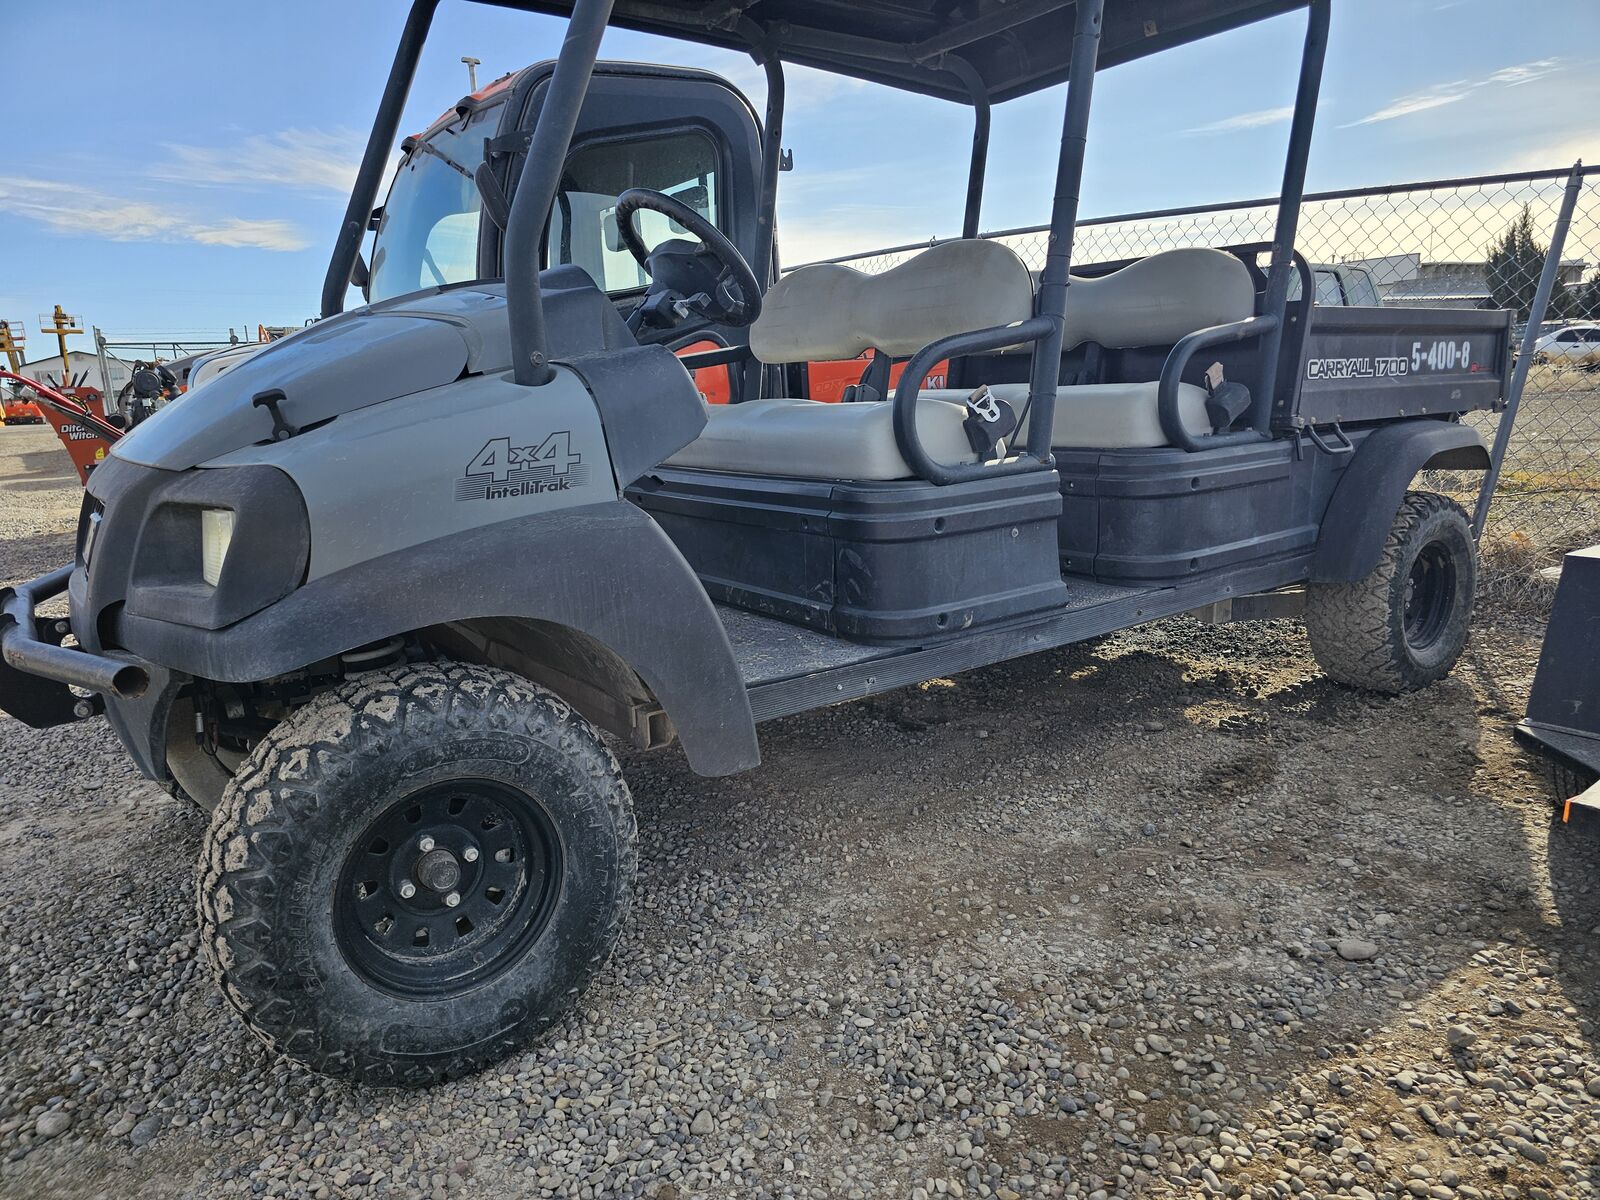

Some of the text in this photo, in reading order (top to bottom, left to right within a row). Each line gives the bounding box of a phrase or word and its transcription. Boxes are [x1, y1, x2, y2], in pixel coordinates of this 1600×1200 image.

[1411, 341, 1471, 371] 5-400-8
[1308, 357, 1408, 379] CARRYALL 1700
[61, 425, 85, 433] Ditc
[466, 431, 581, 482] 4x4
[486, 478, 570, 500] IntelliTrak
